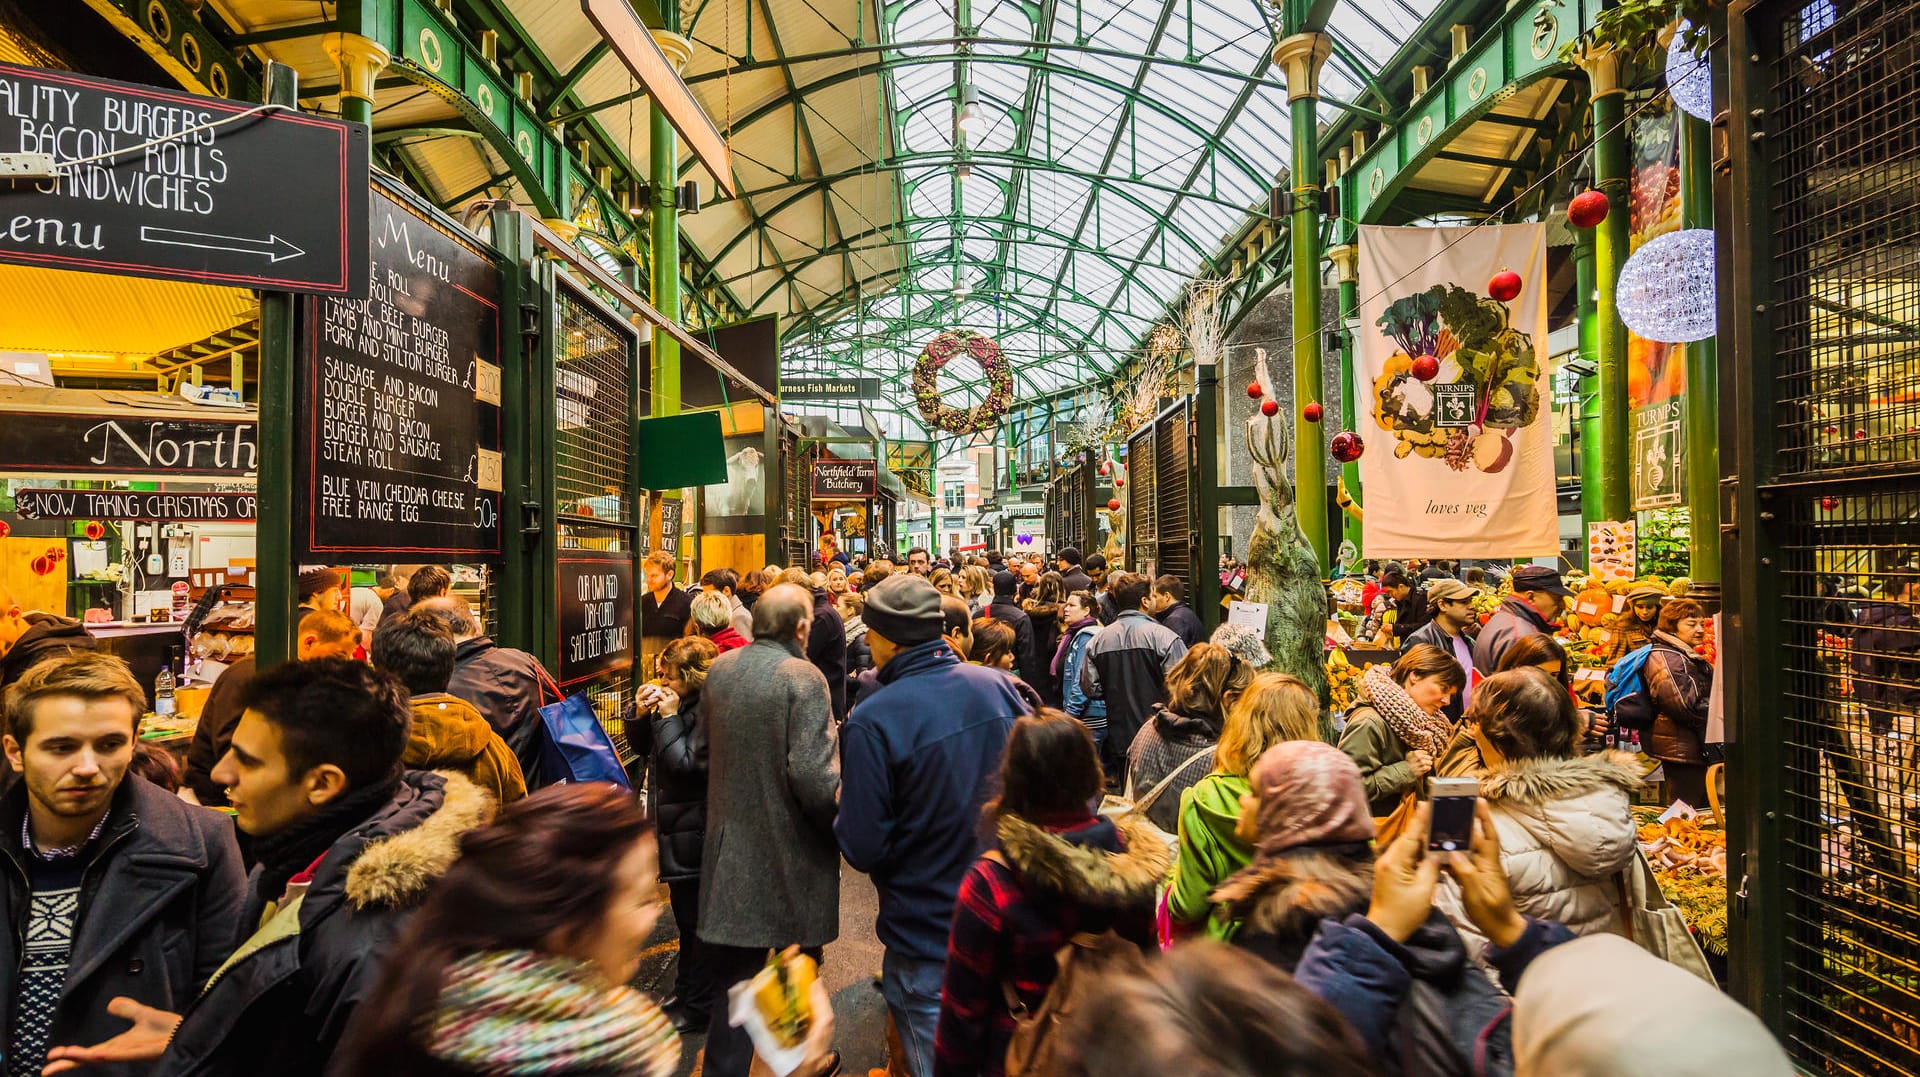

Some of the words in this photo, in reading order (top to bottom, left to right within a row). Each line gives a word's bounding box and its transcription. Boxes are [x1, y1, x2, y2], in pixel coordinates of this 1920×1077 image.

[104, 97, 215, 146] BURGERS
[20, 118, 116, 166] BACON
[145, 138, 228, 183] ROLLS
[0, 215, 105, 250] enu
[378, 214, 450, 283] Menu
[370, 280, 394, 307] ROLL
[388, 269, 411, 297] ROLL
[325, 300, 357, 330] LAMB
[361, 316, 383, 340] AND
[385, 326, 410, 350] MINT
[415, 337, 450, 366] BURGER
[381, 304, 405, 330] BEEF
[412, 317, 450, 348] BURGER
[325, 322, 355, 350] PORK
[358, 334, 380, 358] AND
[382, 343, 422, 373] STILTON
[425, 359, 458, 385] BURGER
[324, 356, 376, 390] SAUSAGE
[384, 375, 405, 398] AND
[408, 382, 438, 408] BACON
[324, 377, 367, 407] DOUBLE
[374, 391, 415, 419] BURGER
[807, 383, 823, 393] Fish
[825, 383, 856, 393] Markets
[1435, 384, 1475, 392] TURNIPS
[324, 398, 367, 426] BURGER
[372, 410, 393, 432] AND
[399, 416, 430, 440] BACON
[83, 420, 257, 469] North
[323, 418, 369, 447] BURGER
[373, 430, 395, 452] AND
[399, 435, 442, 461] SAUSAGE
[323, 440, 362, 465] STEAK
[367, 448, 394, 471] ROLL
[815, 465, 855, 480] Northfield
[854, 465, 874, 477] Farm
[822, 478, 863, 493] Butchery
[35, 493, 75, 517] NOW
[85, 494, 139, 518] TAKING
[146, 496, 228, 518] CHRISTMAS
[322, 496, 352, 518] FREE
[358, 500, 394, 521] RANGE
[401, 504, 419, 523] EGG
[323, 475, 351, 497] BLUE
[356, 480, 380, 501] VEIN
[384, 483, 428, 506] CHEDDAR
[432, 489, 465, 510] CHEESE
[1425, 499, 1460, 514] loves
[1465, 503, 1488, 518] veg
[577, 575, 591, 602] OUR
[591, 575, 604, 601] OWN
[570, 631, 586, 663] SALT
[588, 629, 602, 659] BEEF
[604, 626, 628, 655] SANDWICH
